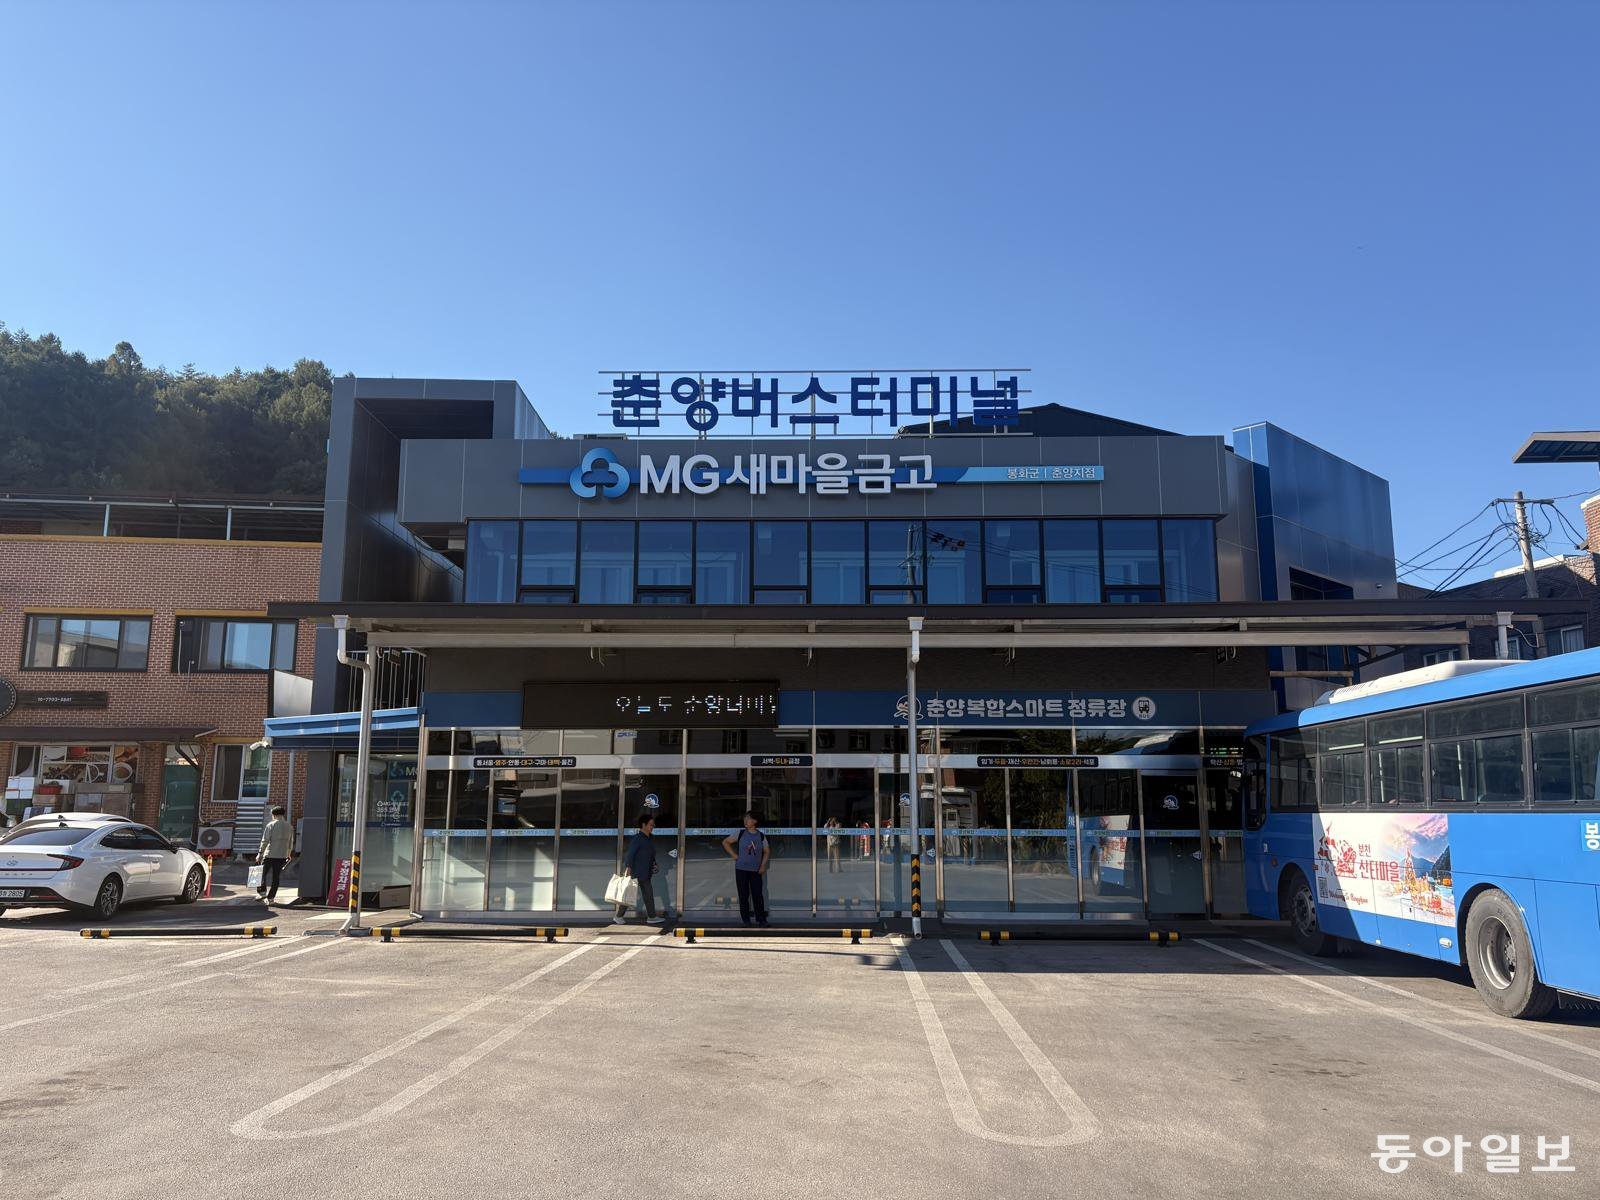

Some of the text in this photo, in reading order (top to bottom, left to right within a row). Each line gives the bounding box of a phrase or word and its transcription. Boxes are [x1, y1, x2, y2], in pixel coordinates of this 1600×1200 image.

[611, 375, 1019, 431] 춘양버스터미널
[639, 453, 938, 495] MG새마을금고
[1008, 467, 1096, 479] 봉화군 춘양지점
[926, 698, 1127, 718] 춘양복합스마트 정류장
[1585, 822, 1600, 850] 봉
[1358, 843, 1371, 857] 분천
[1359, 859, 1400, 883] 산타마을
